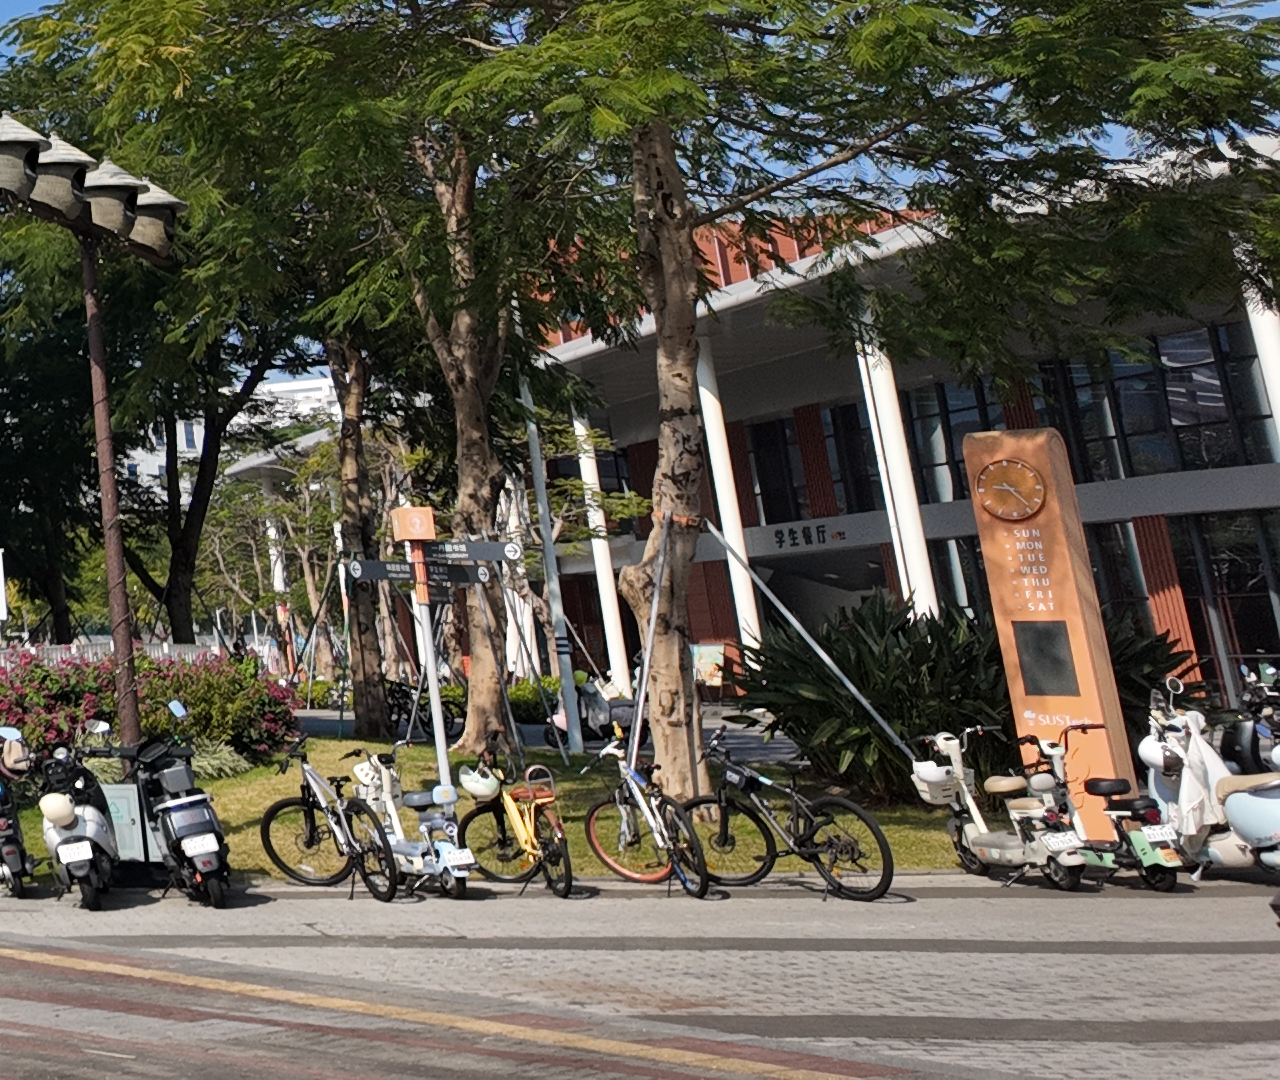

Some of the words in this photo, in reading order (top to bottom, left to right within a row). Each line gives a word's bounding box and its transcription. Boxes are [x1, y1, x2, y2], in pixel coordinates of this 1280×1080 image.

[774, 525, 827, 549] 学生餐厅
[1013, 529, 1041, 538] SUN
[1015, 541, 1043, 550] MON
[1018, 553, 1045, 562] TUE
[1020, 565, 1048, 574] WED
[1022, 578, 1050, 587] THU
[1025, 590, 1053, 599] FRI
[1027, 602, 1055, 611] SAT
